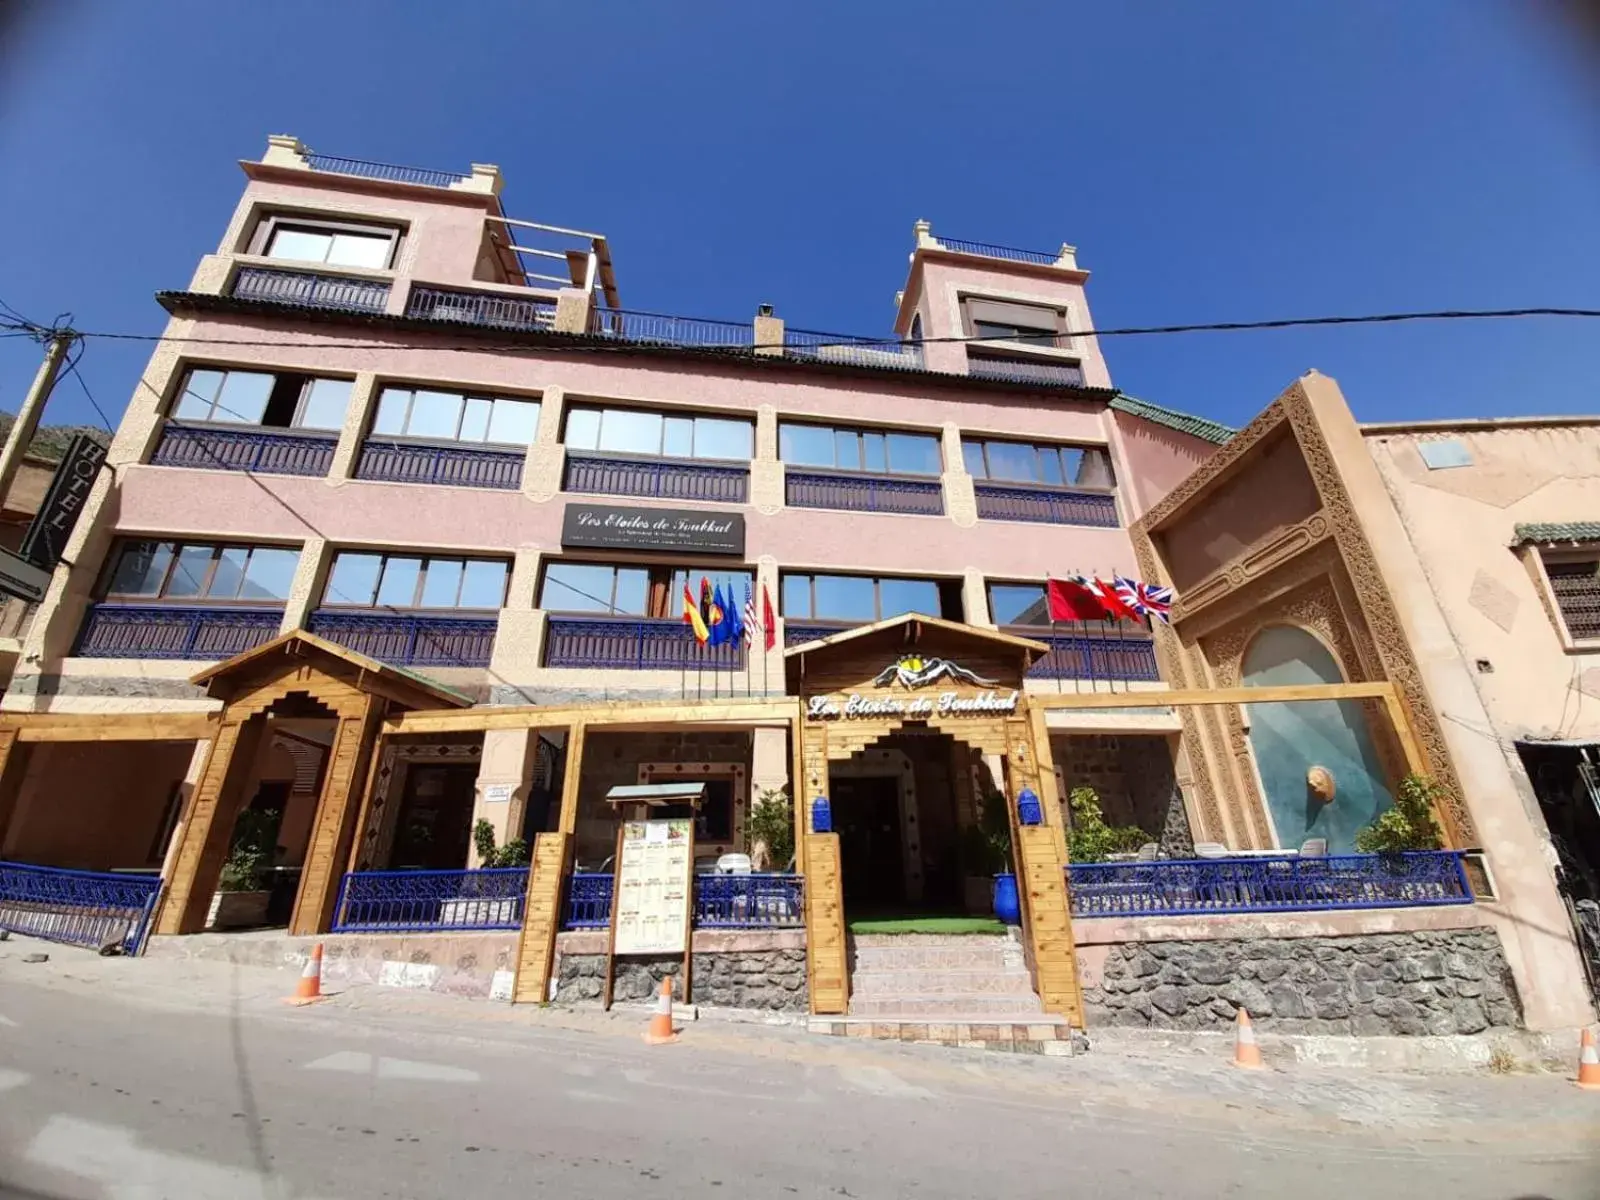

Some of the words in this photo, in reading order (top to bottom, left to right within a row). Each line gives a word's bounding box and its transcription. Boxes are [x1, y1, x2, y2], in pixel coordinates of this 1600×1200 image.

[50, 442, 105, 530] HOTEL
[577, 512, 602, 527] Les
[605, 513, 650, 530] Etoiles
[652, 518, 670, 530] de
[673, 518, 732, 534] Toubkal
[808, 696, 841, 714] Les
[909, 696, 933, 713] de
[937, 690, 1020, 712] Toubkal
